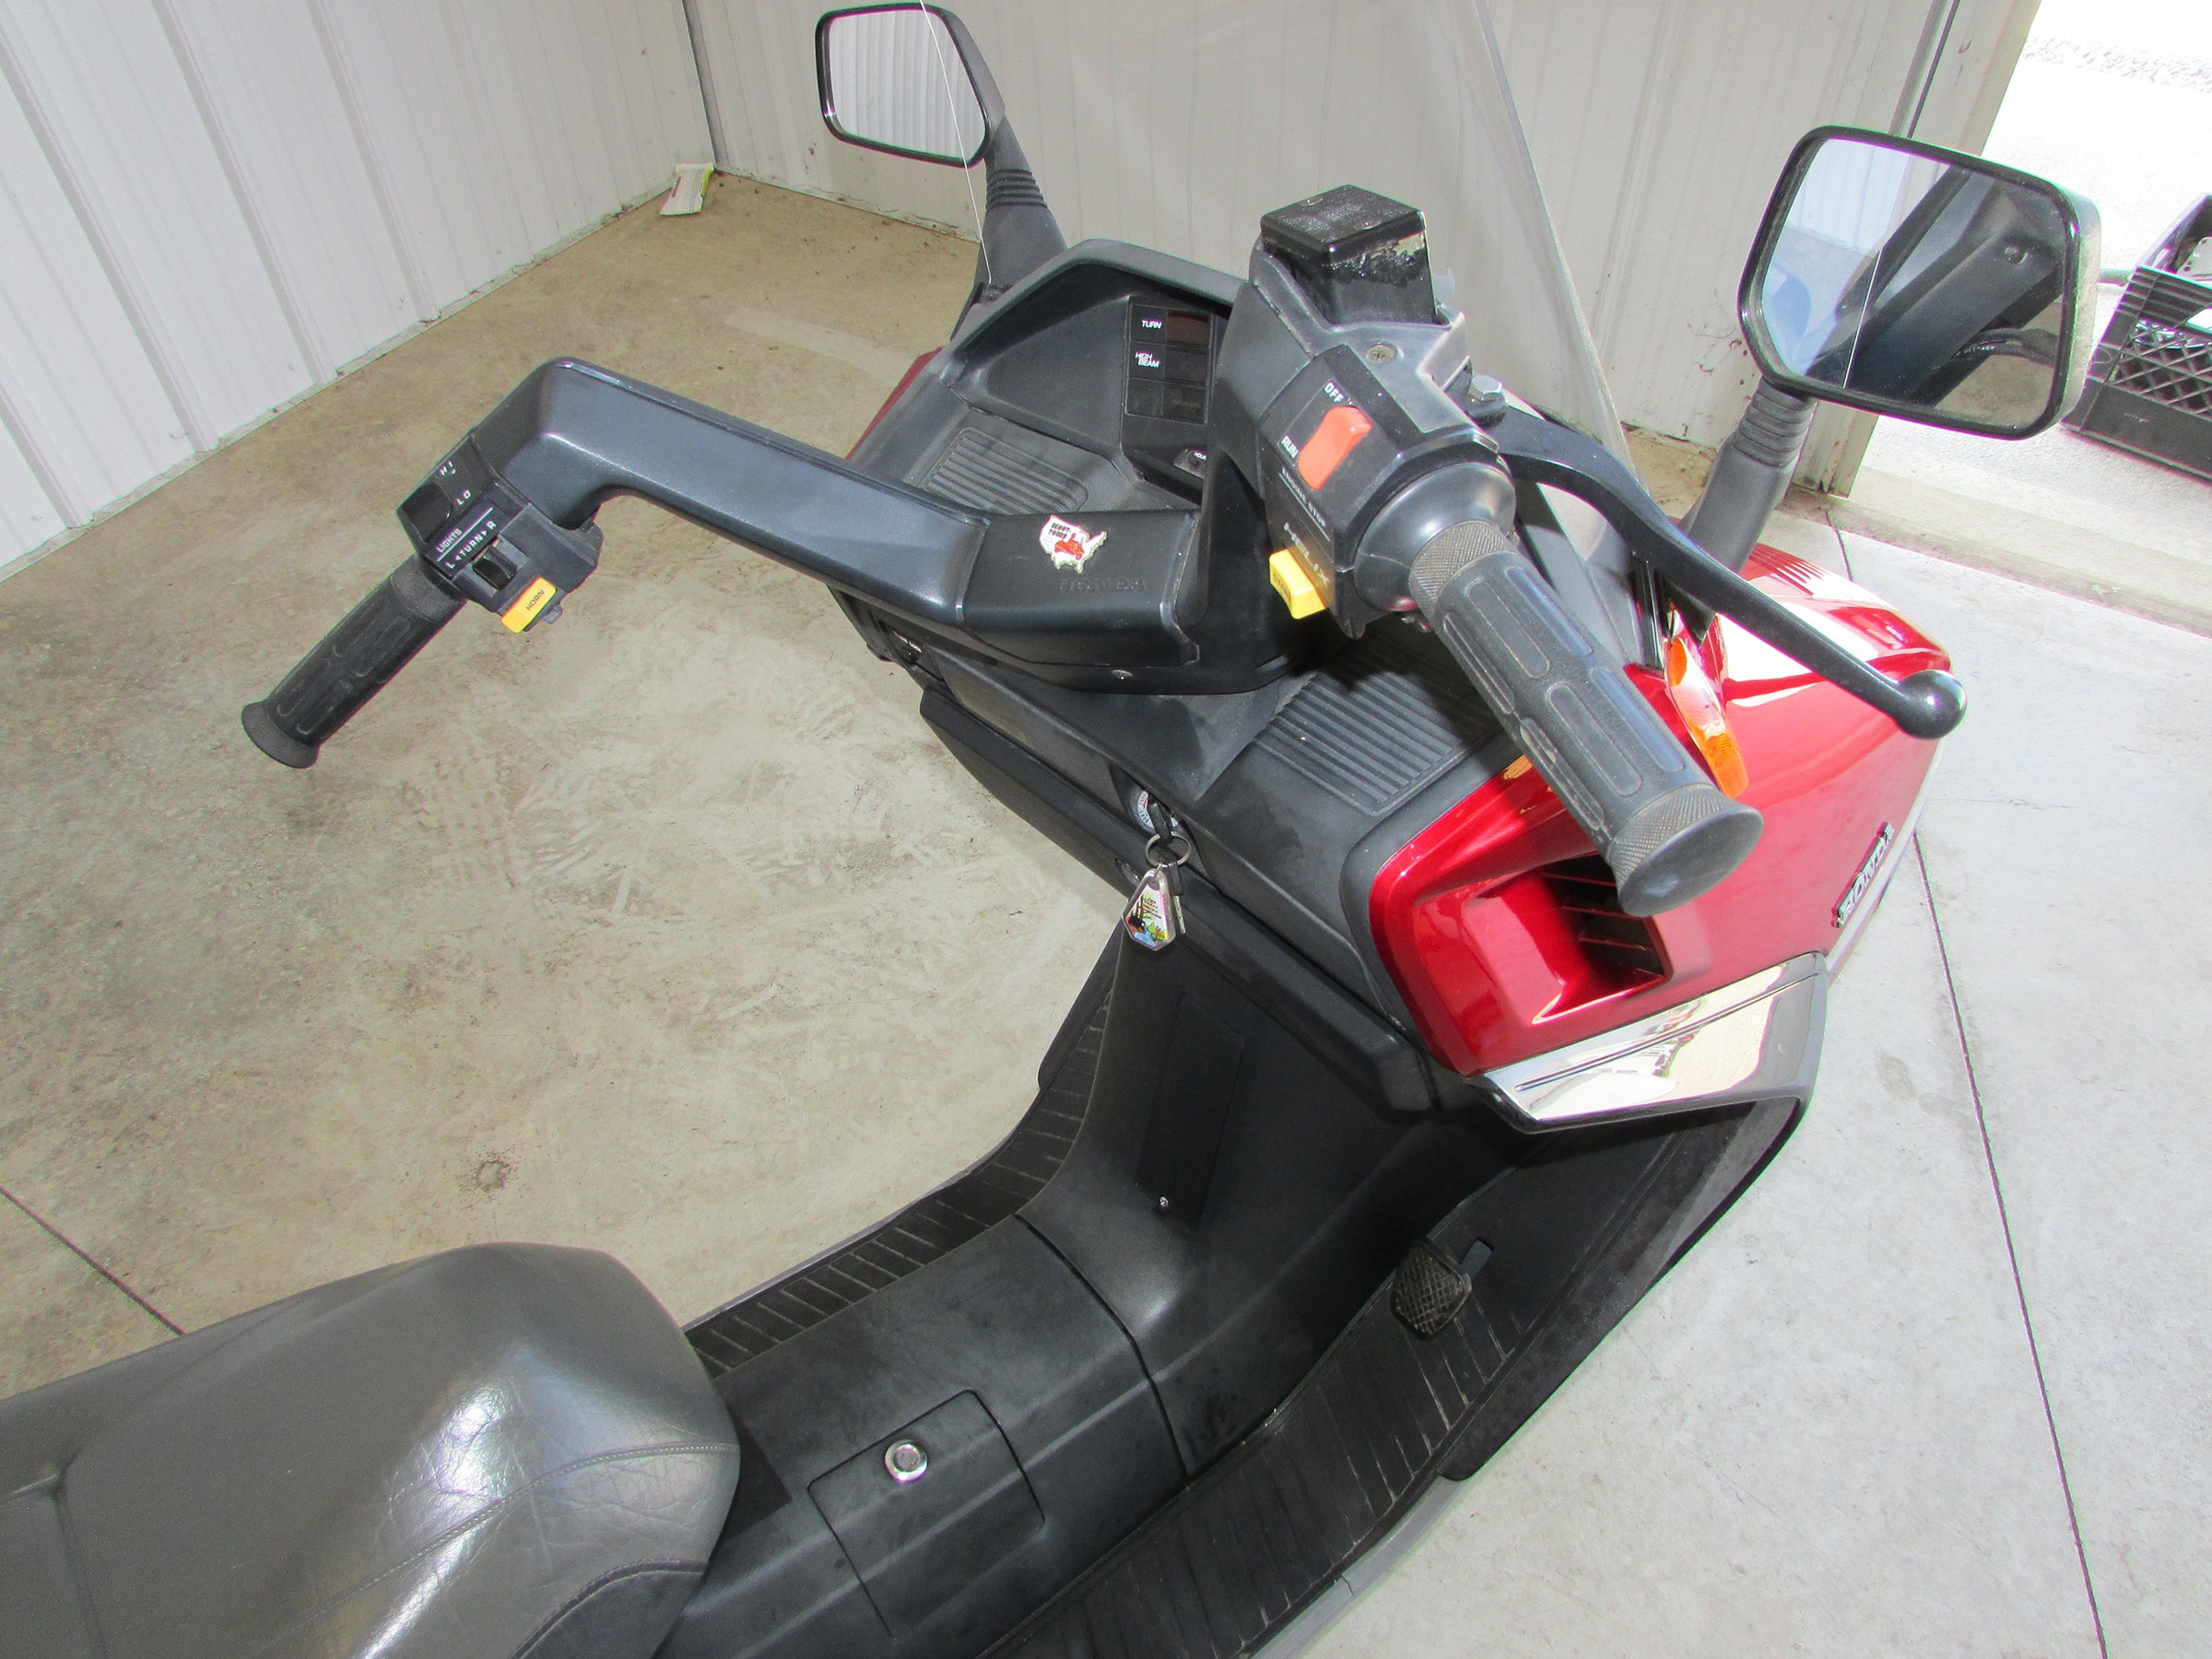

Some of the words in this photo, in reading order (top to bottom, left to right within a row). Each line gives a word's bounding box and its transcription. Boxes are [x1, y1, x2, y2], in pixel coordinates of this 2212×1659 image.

[1141, 319, 1162, 329] TURN
[1135, 351, 1153, 360] HIGH
[1137, 359, 1159, 368] BEAM
[1324, 382, 1343, 403] OFF
[1280, 435, 1299, 459] RUN
[456, 489, 472, 505] LO
[1308, 500, 1326, 527] STOP
[436, 528, 463, 553] LIGHTS
[445, 561, 456, 570] L
[459, 534, 484, 557] TURN
[486, 520, 497, 531] R
[1284, 522, 1330, 587] HELIX
[525, 589, 546, 611] HORN
